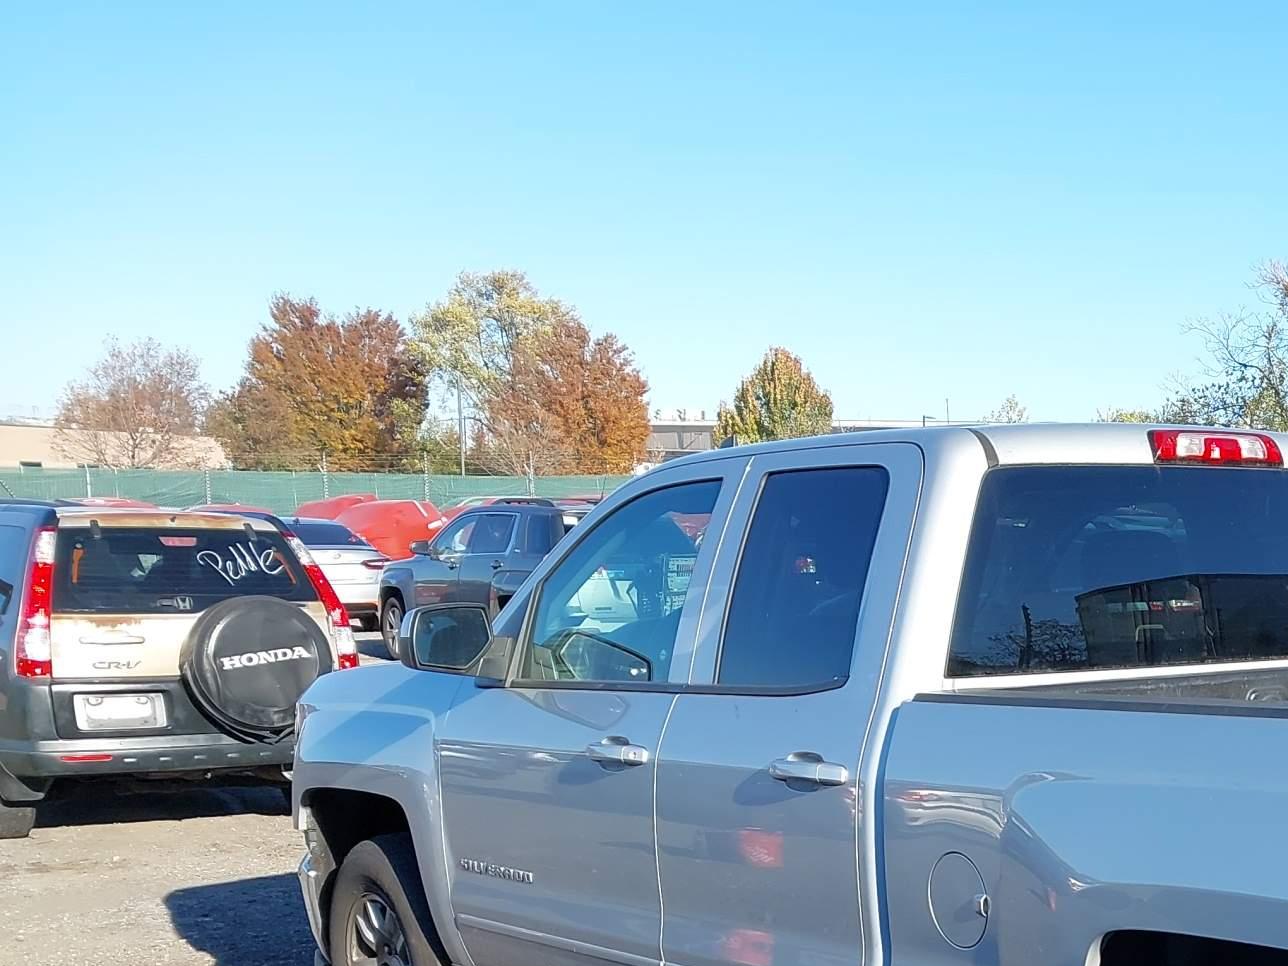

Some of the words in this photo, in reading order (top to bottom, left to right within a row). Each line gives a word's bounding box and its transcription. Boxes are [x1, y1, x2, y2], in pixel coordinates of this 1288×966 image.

[92, 660, 142, 670] CR-V
[220, 646, 312, 670] HONDA
[460, 858, 534, 885] SILVERADO
